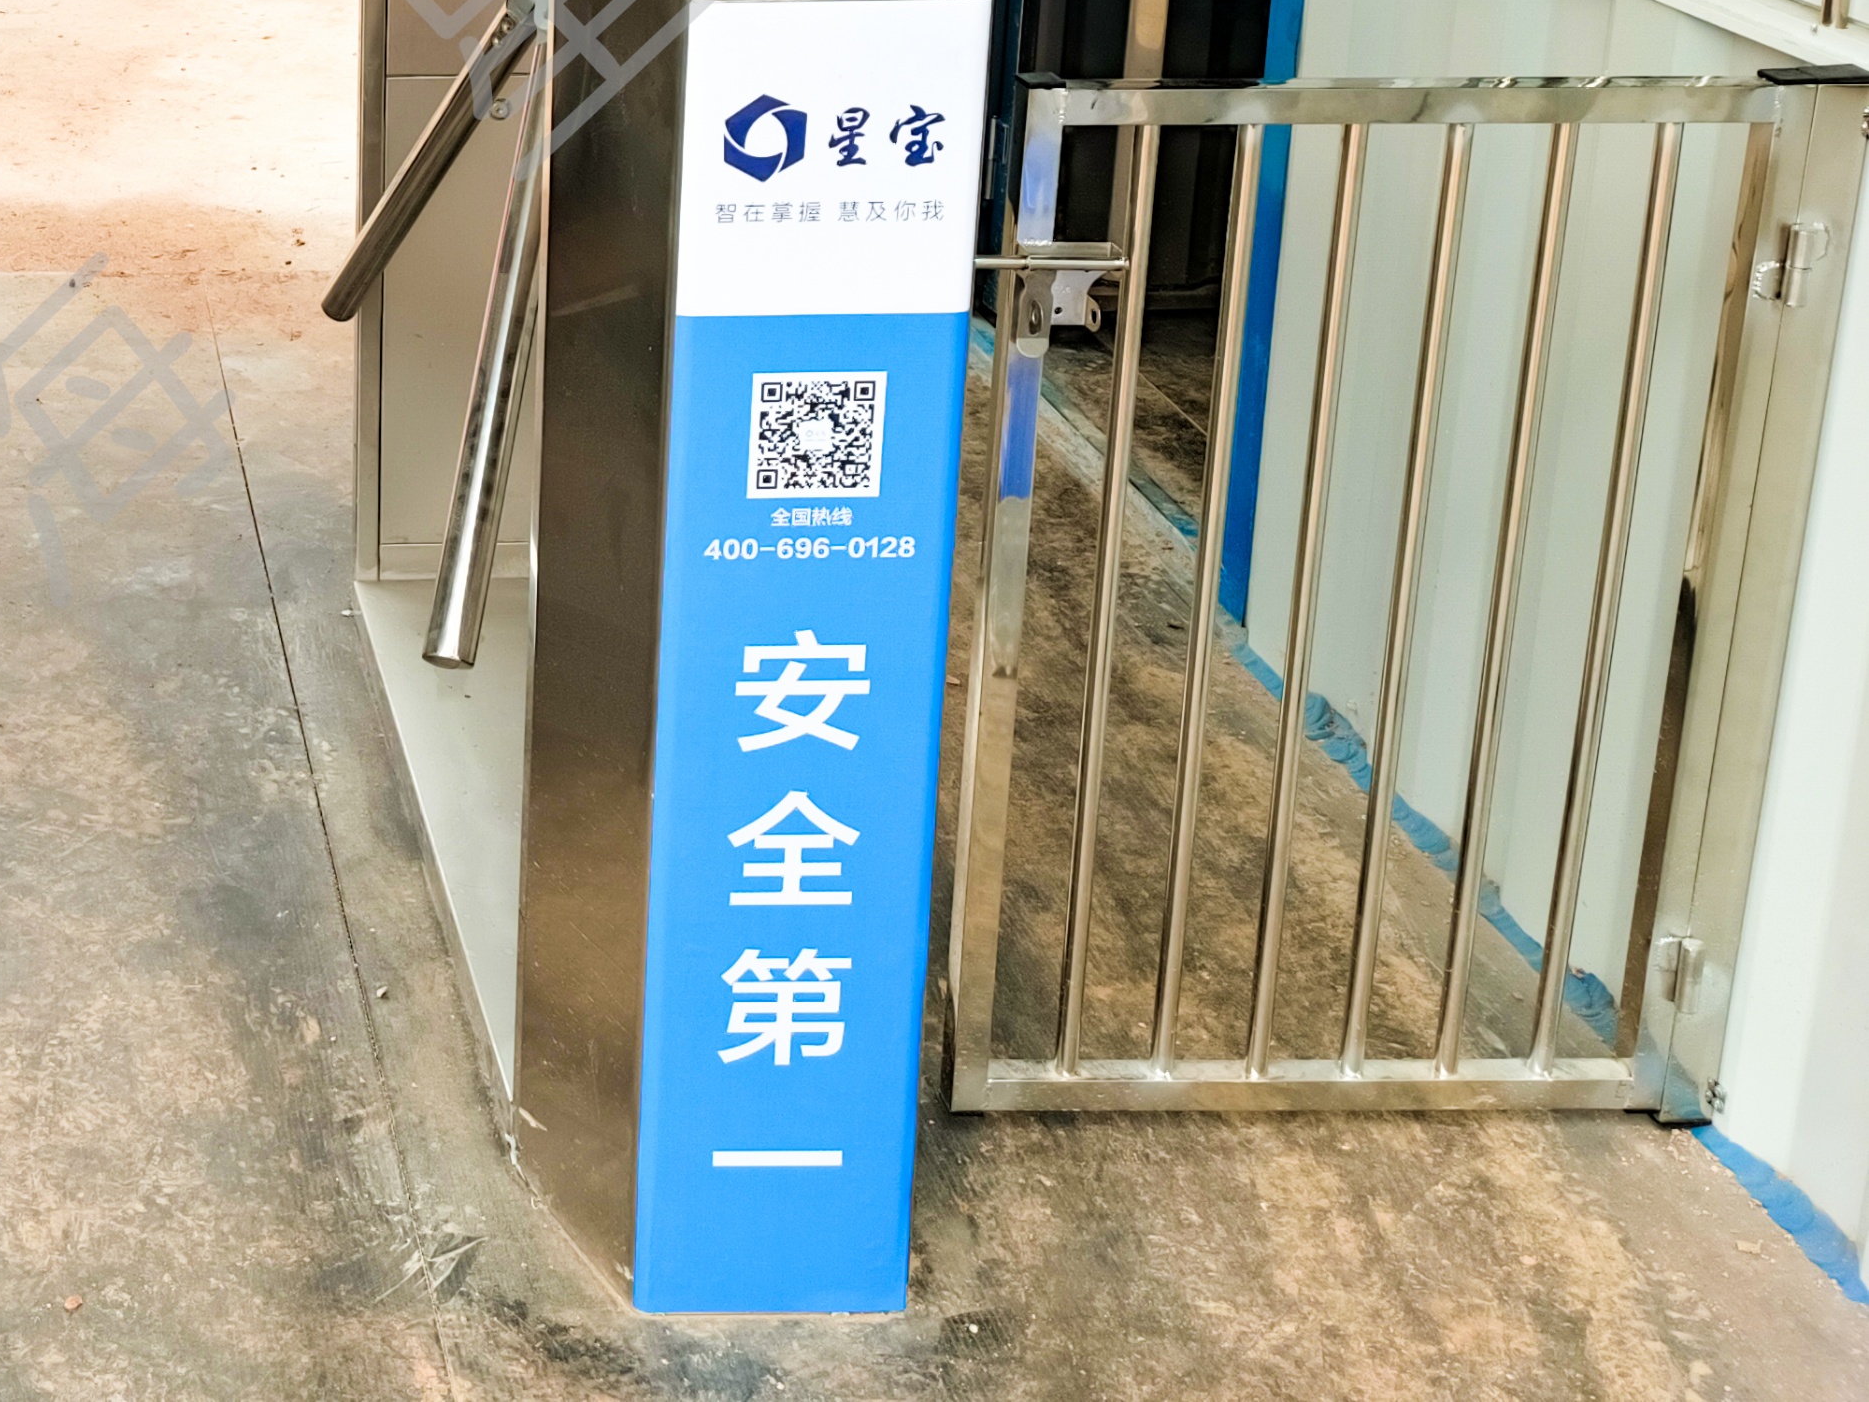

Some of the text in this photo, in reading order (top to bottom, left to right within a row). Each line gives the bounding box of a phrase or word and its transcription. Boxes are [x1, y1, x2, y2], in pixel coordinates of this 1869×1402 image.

[828, 104, 946, 167] 星宝
[715, 200, 945, 224] 智在掌握 慧及你我
[770, 506, 853, 527] 全国热线
[703, 536, 916, 560] 400-696-0128
[712, 629, 871, 1168] 安全第一
